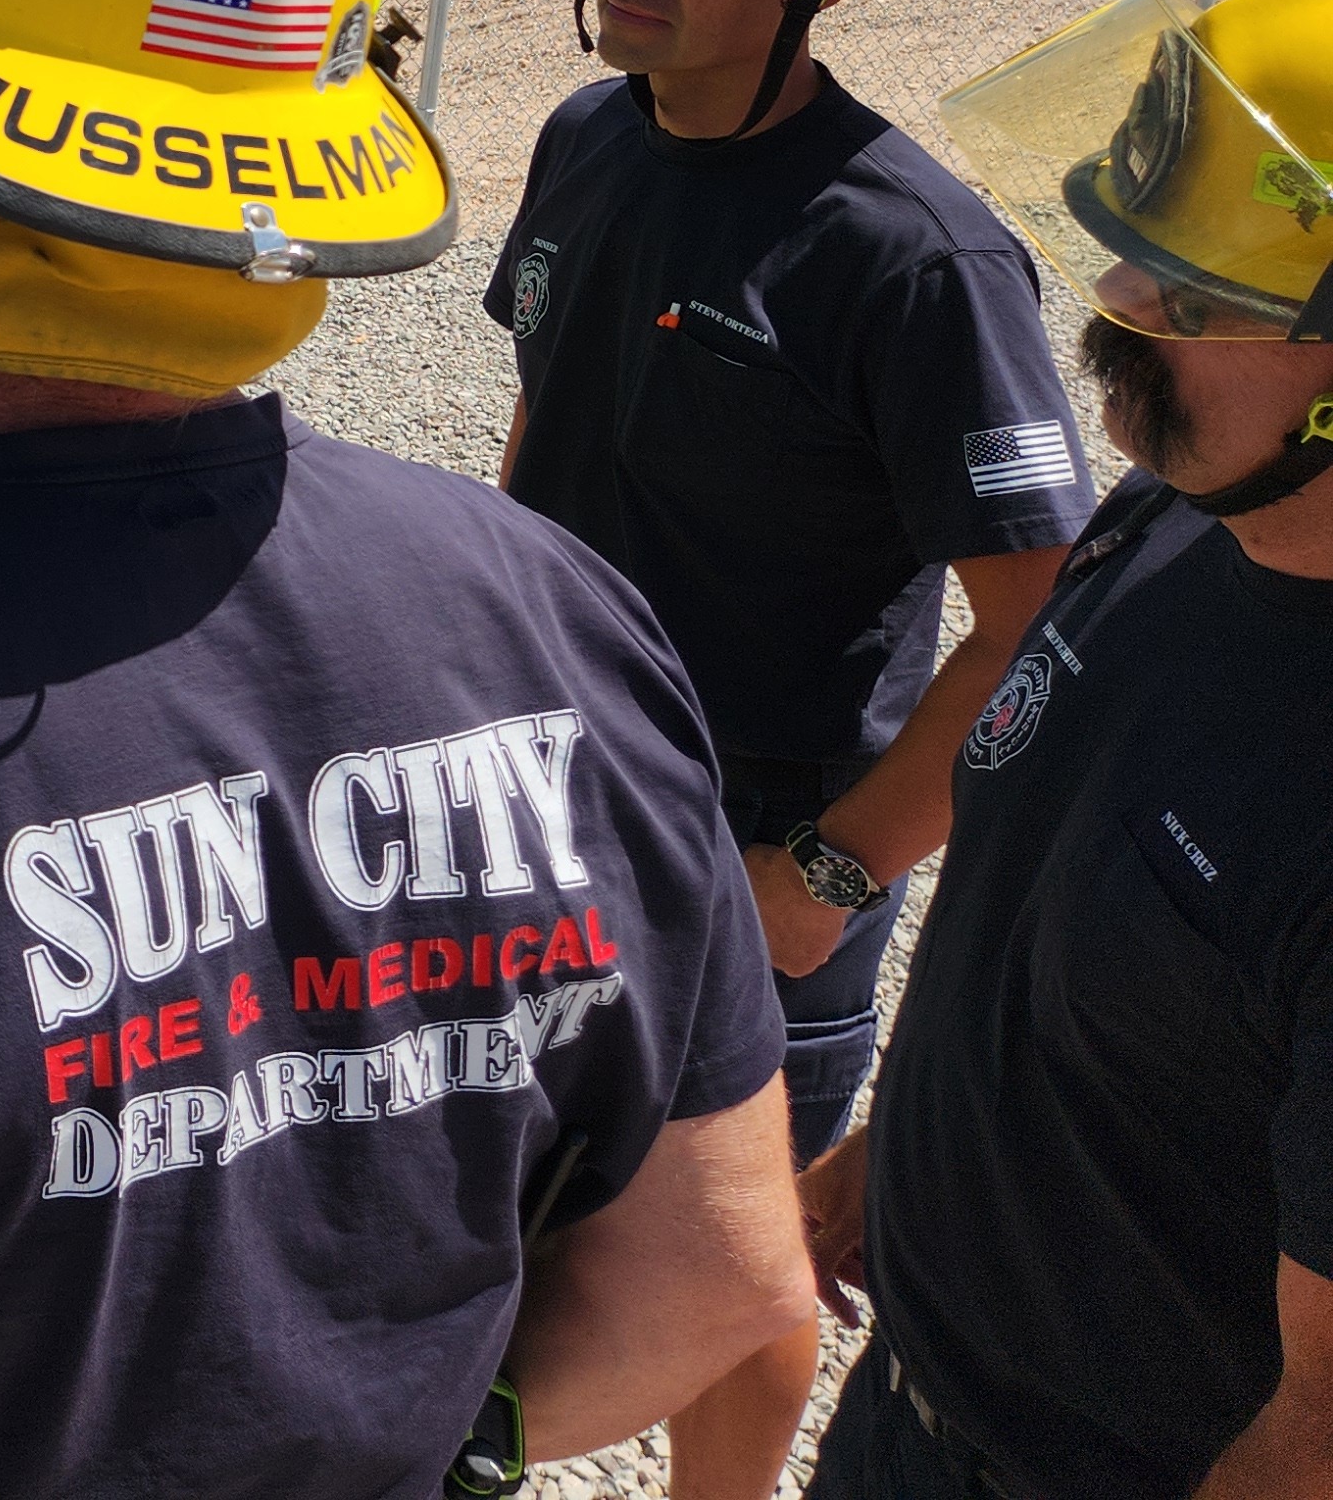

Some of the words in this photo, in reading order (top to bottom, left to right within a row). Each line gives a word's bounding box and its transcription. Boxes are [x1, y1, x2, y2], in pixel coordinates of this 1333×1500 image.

[688, 300, 725, 323] STEVE
[724, 317, 769, 344] ORTEGA
[3, 771, 268, 1032] SUN
[307, 708, 590, 911] CITY
[1160, 810, 1190, 846] NICK
[1184, 842, 1218, 882] CRUZ
[41, 971, 623, 1199] DEPARTMENT
[44, 997, 203, 1104] FIRE
[227, 972, 263, 1037] &
[293, 907, 619, 1011] MEDICAL
